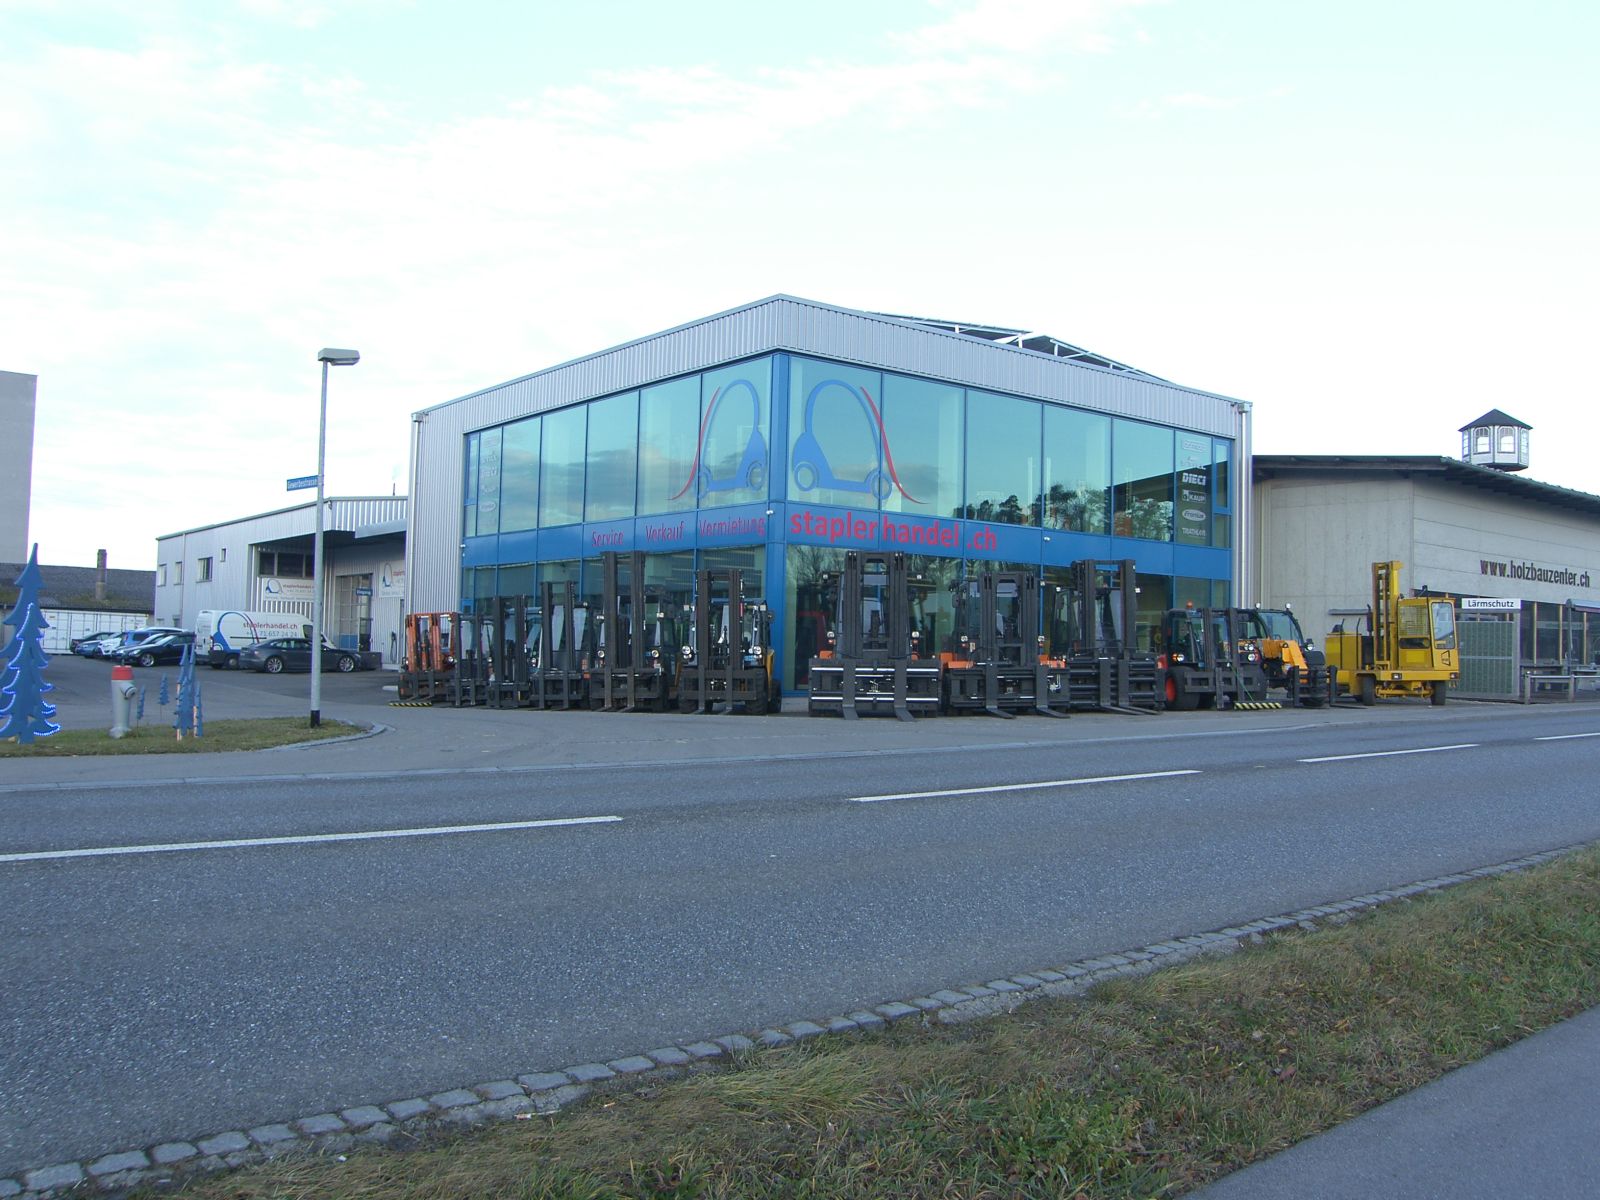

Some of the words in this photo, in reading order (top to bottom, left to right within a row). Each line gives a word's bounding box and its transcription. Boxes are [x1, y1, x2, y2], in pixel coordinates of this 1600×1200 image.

[592, 529, 624, 547] Service
[645, 521, 685, 542] Verkauf
[700, 514, 766, 537] Vermietung
[1480, 559, 1590, 588] www.holzbauzenter.ch
[1467, 599, 1514, 608] Lärmschutz
